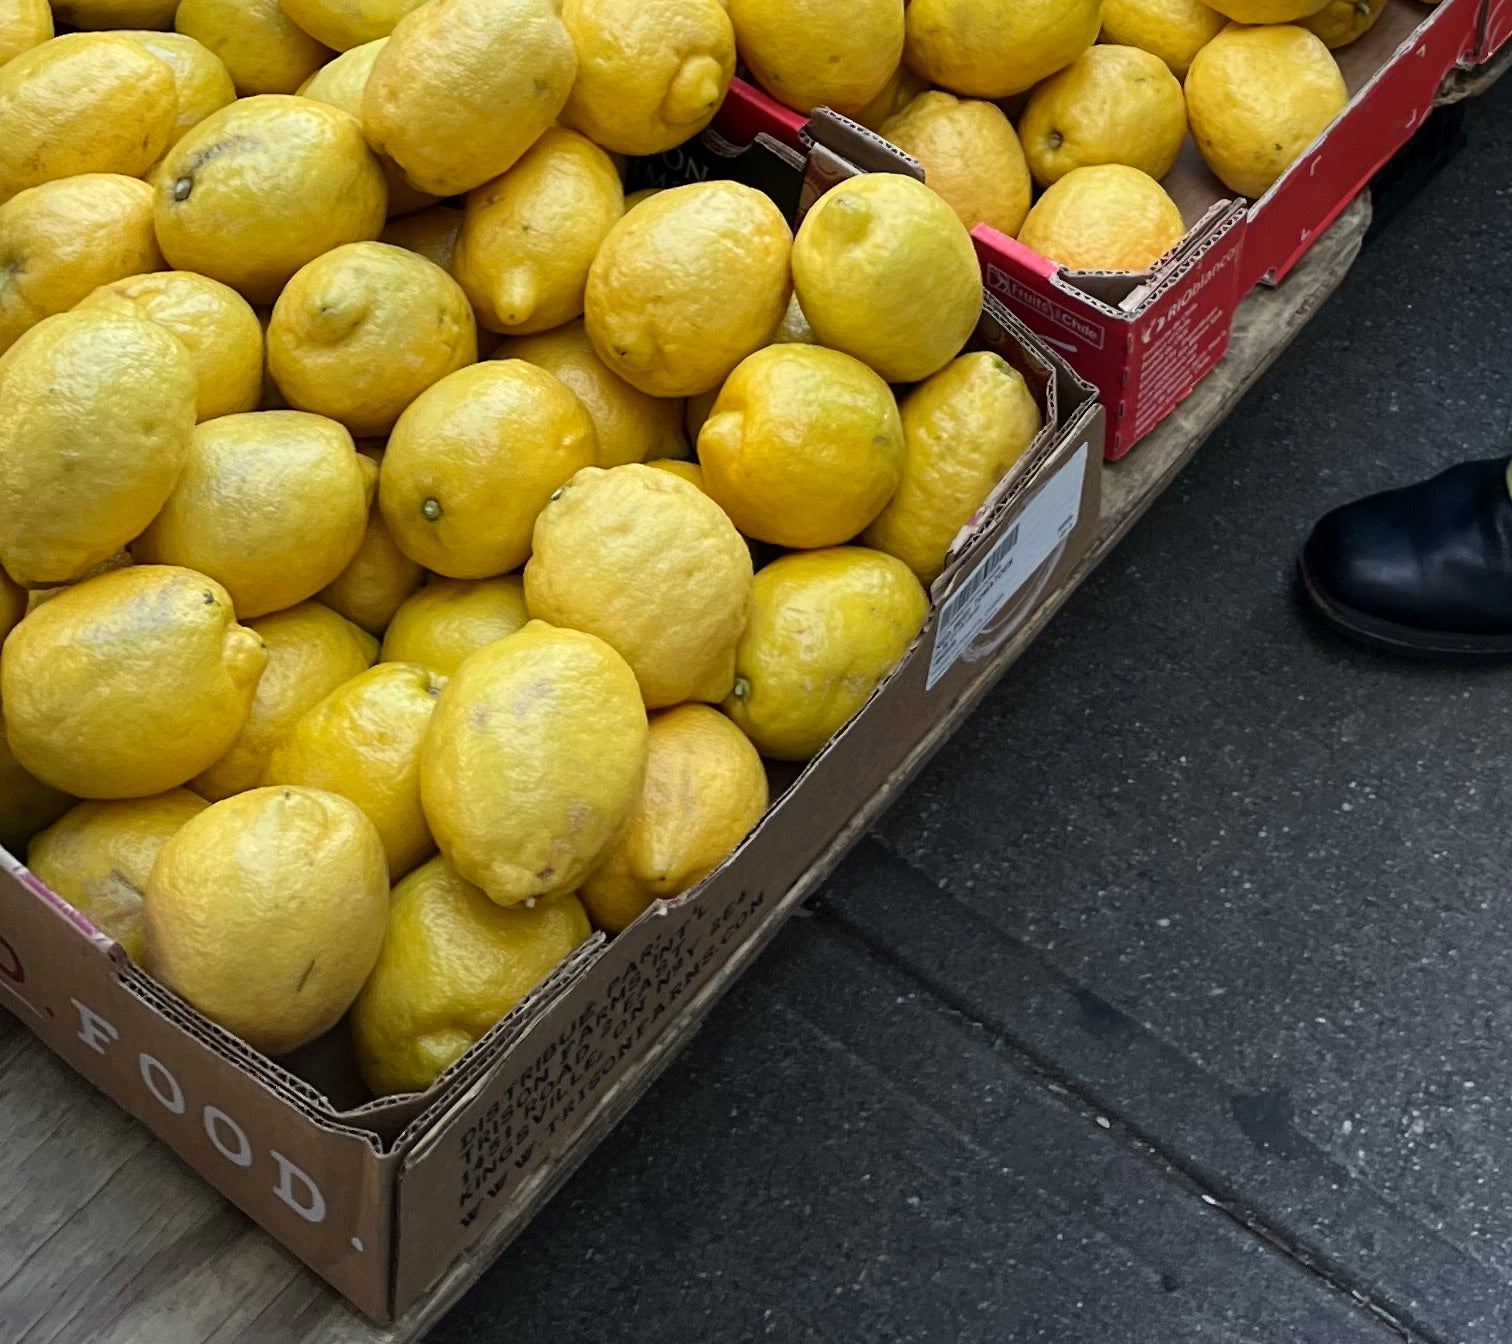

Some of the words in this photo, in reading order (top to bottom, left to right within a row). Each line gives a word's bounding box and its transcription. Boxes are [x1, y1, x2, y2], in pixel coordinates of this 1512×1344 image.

[1011, 281, 1050, 312] Fruits
[1061, 313, 1098, 340] Chile
[460, 1050, 603, 1209] KINGSVILLE
[614, 997, 646, 1040] ON
[461, 1067, 549, 1164] TRISON
[561, 968, 643, 1063] FARMS
[525, 1043, 590, 1120] ROAD
[625, 938, 687, 1013] EAST
